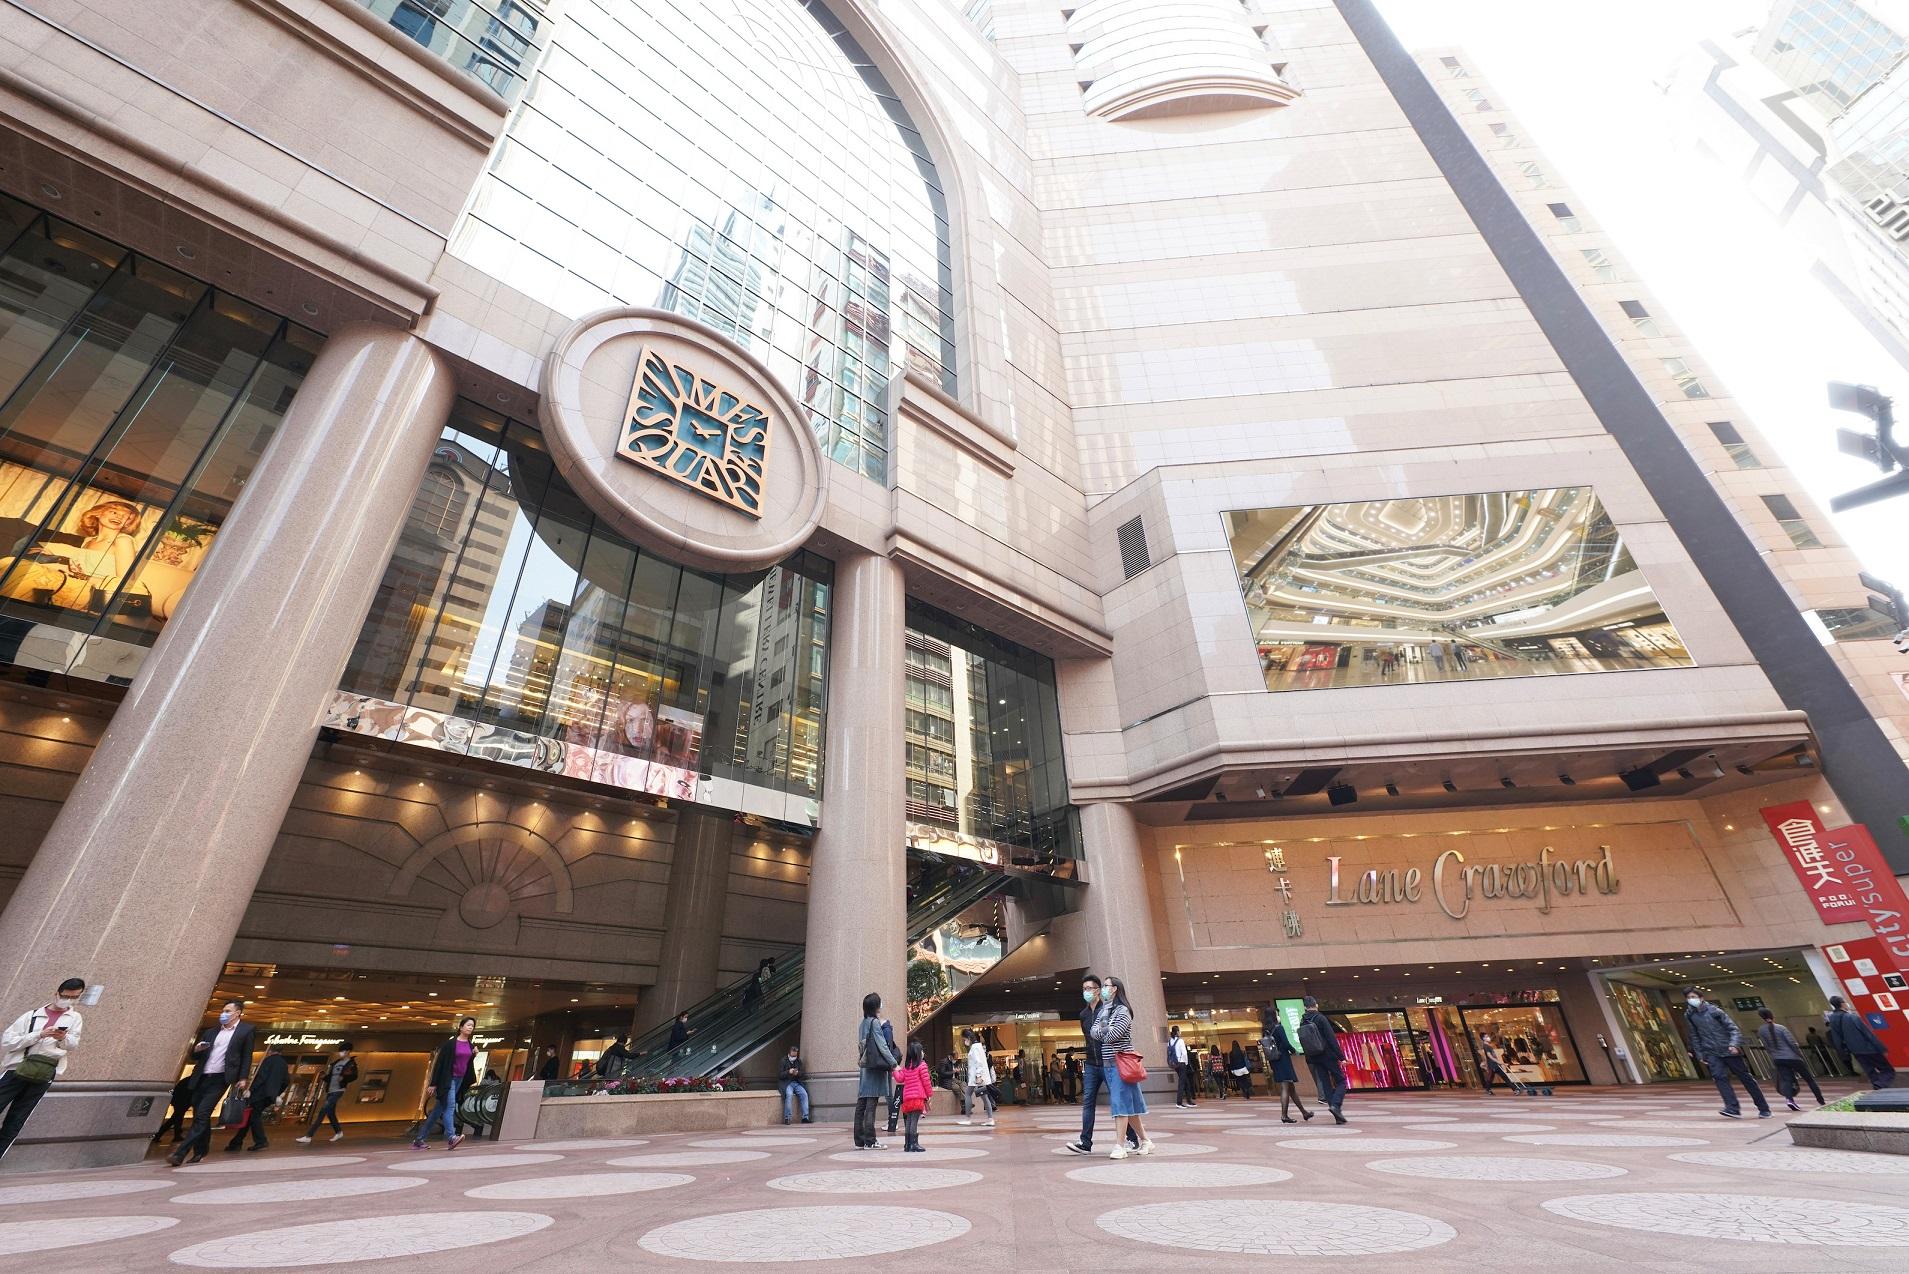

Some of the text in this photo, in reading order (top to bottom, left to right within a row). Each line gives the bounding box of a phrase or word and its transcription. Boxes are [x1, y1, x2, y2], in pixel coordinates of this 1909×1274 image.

[1265, 846, 1304, 938] 連卡佛
[1326, 845, 1621, 920] Lane Crawford
[1818, 893, 1854, 903] FOO
